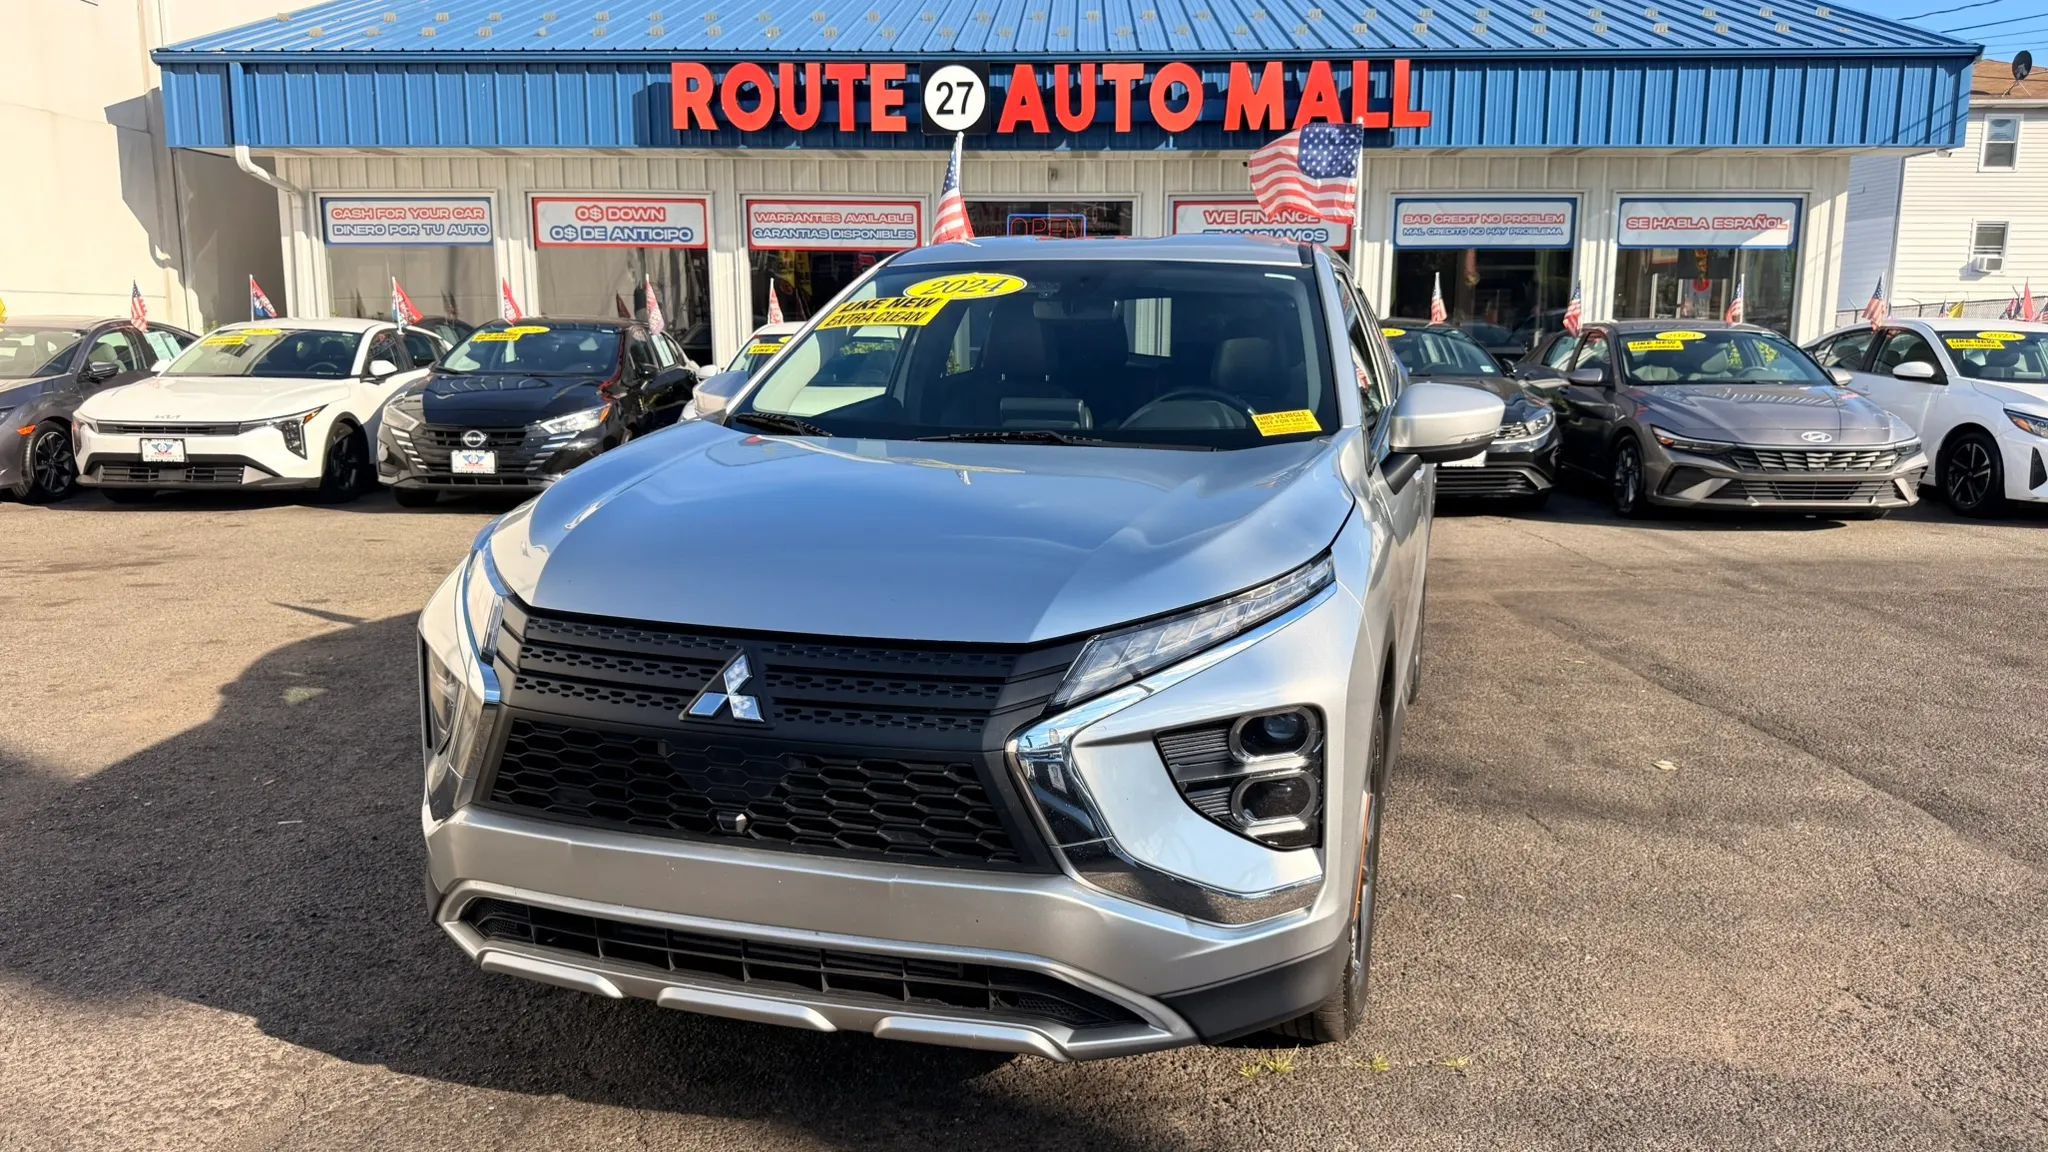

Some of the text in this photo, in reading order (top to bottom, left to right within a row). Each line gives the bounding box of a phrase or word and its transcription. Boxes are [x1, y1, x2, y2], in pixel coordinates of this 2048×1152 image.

[673, 61, 1429, 132] ROUTE 27 AUTO MALL
[331, 207, 485, 220] CASH FOR YOUR CAR
[606, 207, 666, 222] DOWN
[754, 212, 914, 225] WARRANTIES AVAILABLE
[1204, 209, 1237, 224] WE
[1403, 213, 1565, 225] BAD CREDIT NO PROBLEM
[1626, 214, 1788, 230] SE HABLA ESPAÑOL
[333, 224, 489, 236] DINERO POR TU AUTO
[580, 226, 607, 241] DE
[609, 227, 693, 242] ANTICIPO
[752, 227, 916, 240] GARANTIAS DISPONIBLES
[1402, 227, 1563, 236] MAL CREDITO NO HAY PROBLEMA
[924, 278, 1008, 295] 2024
[841, 297, 943, 312] LIKE NEW
[826, 311, 927, 326] EXTRA CLEAN
